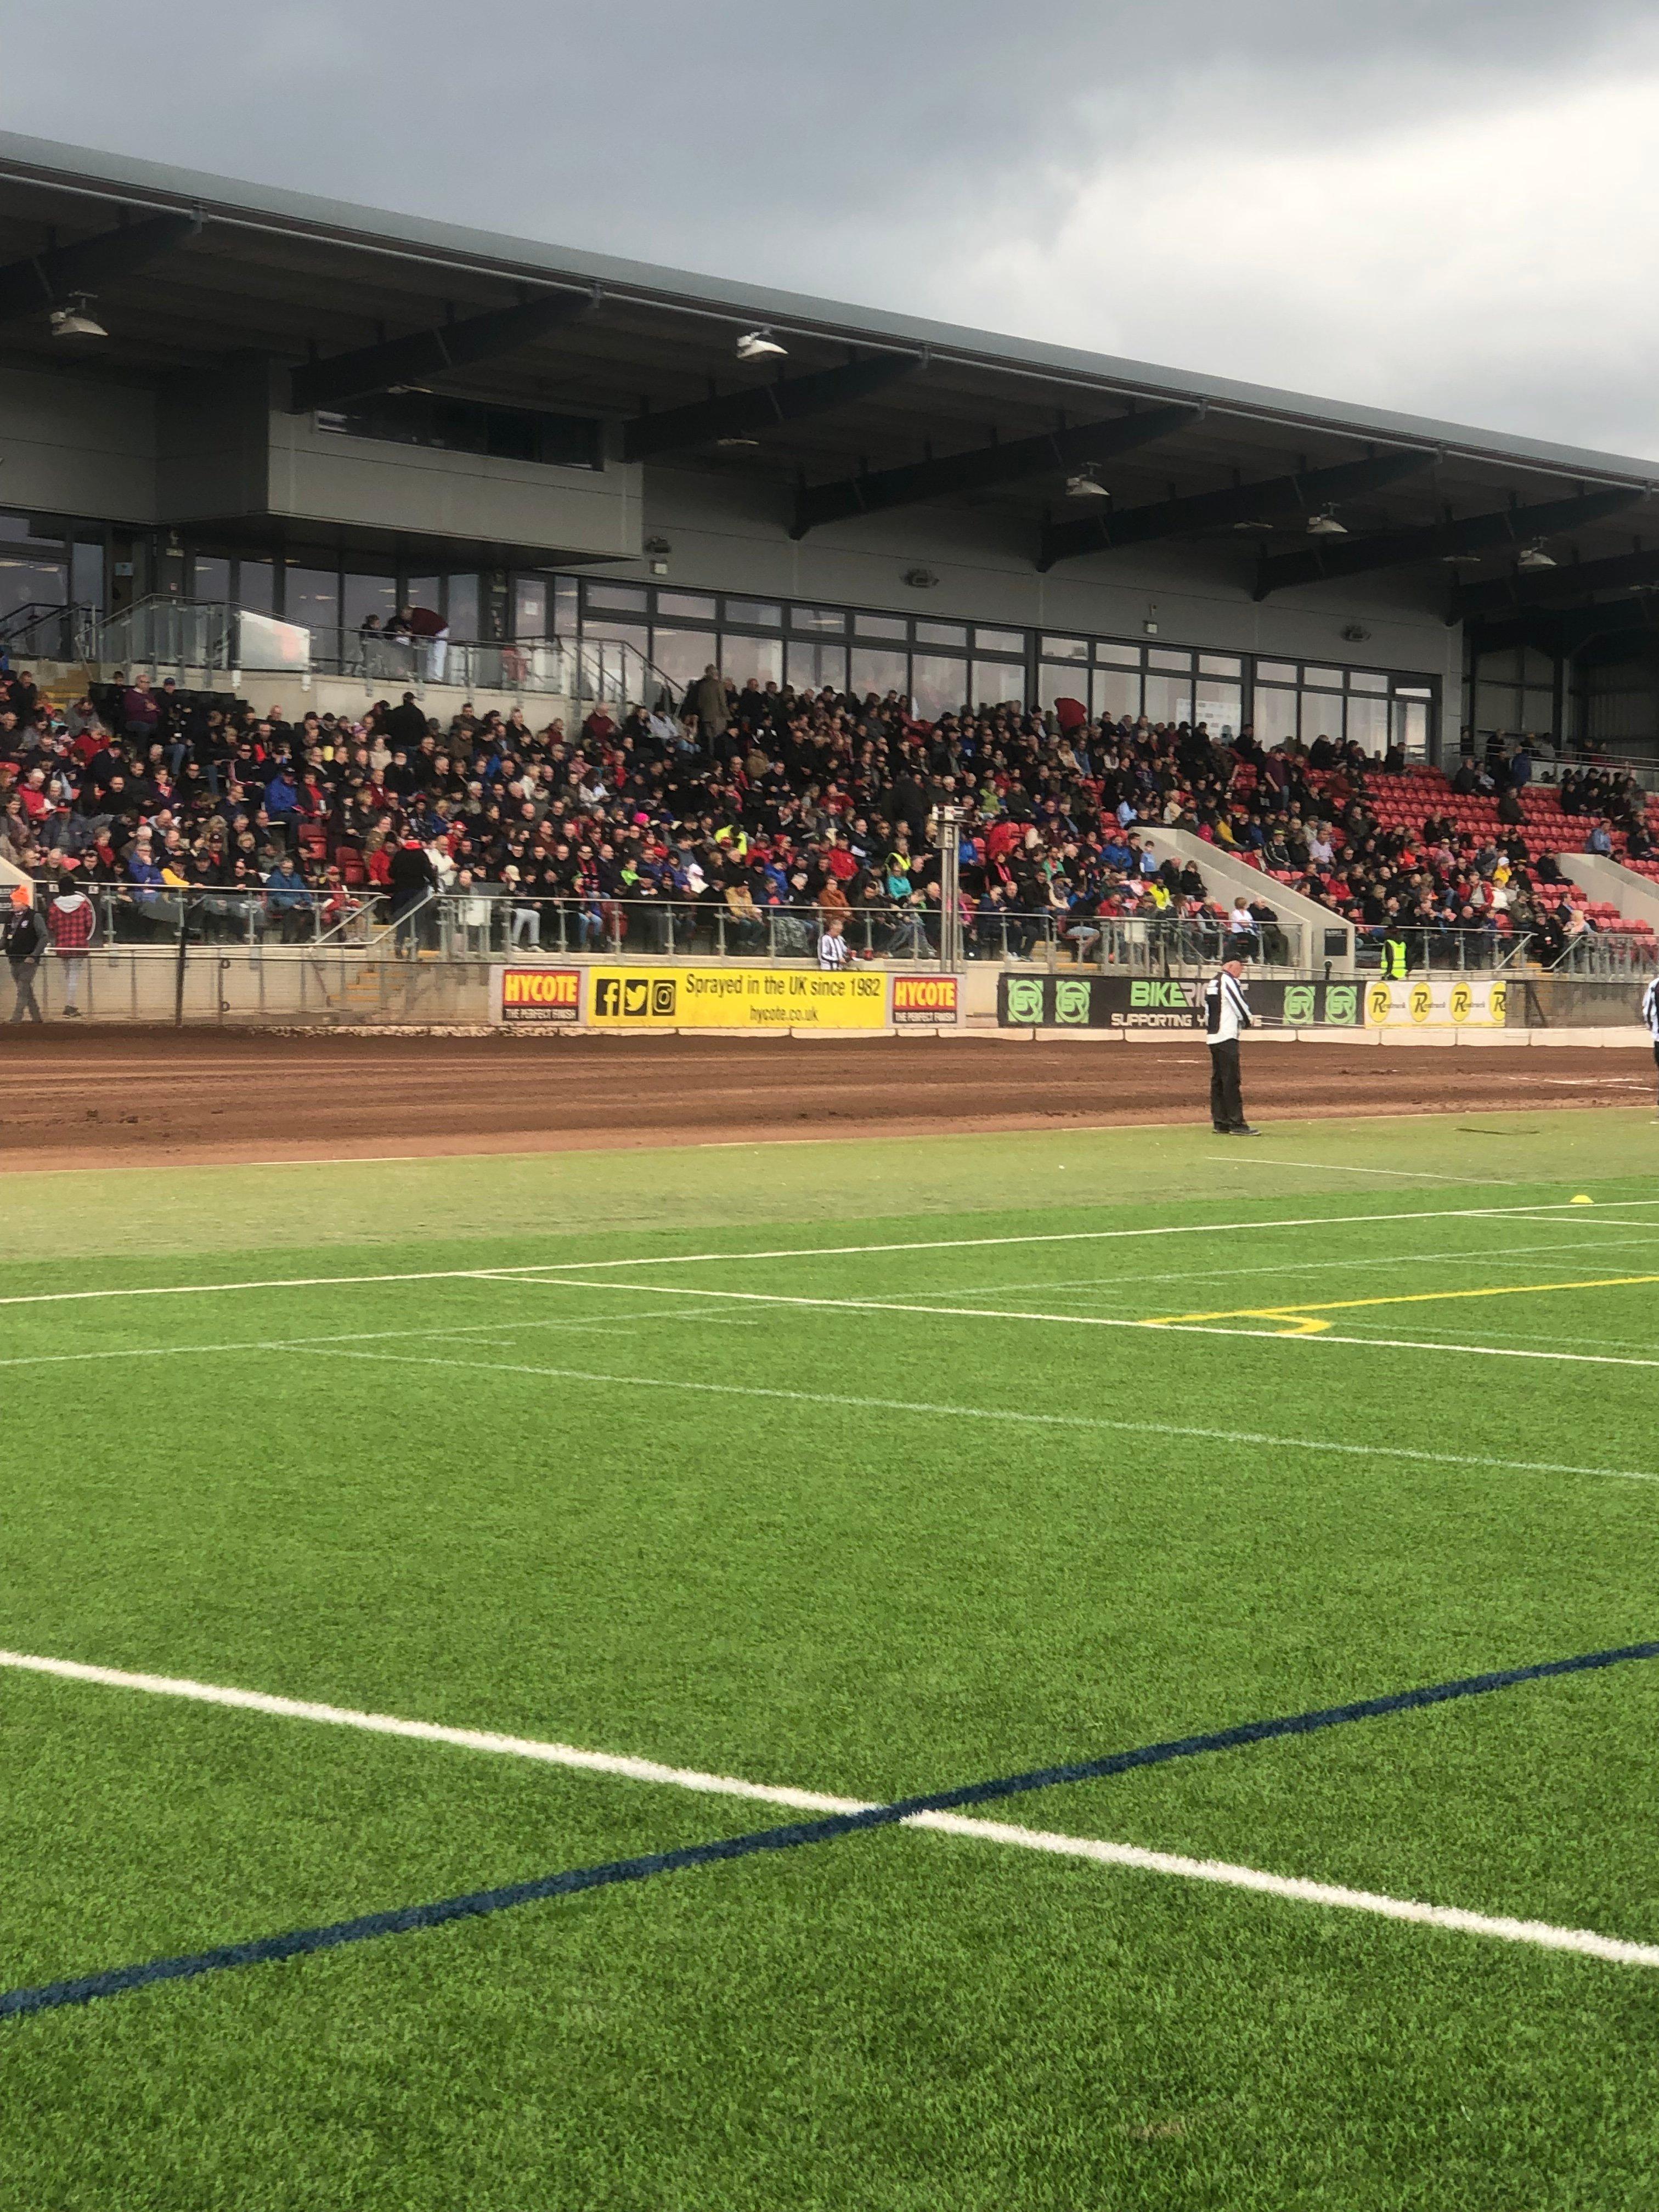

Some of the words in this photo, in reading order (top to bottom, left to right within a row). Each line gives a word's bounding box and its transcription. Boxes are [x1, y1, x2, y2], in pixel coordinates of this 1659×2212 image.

[505, 974, 578, 1002] HYCOTE
[686, 973, 743, 998] Sprayed
[747, 975, 759, 994] in
[764, 975, 785, 995] the
[789, 976, 807, 995] UK
[810, 977, 845, 996] since
[851, 978, 881, 996] 1982
[895, 981, 955, 1006] HYCOTE
[750, 1005, 820, 1024] hycote.co.uk
[1111, 1013, 1193, 1027] SUPPORTING
